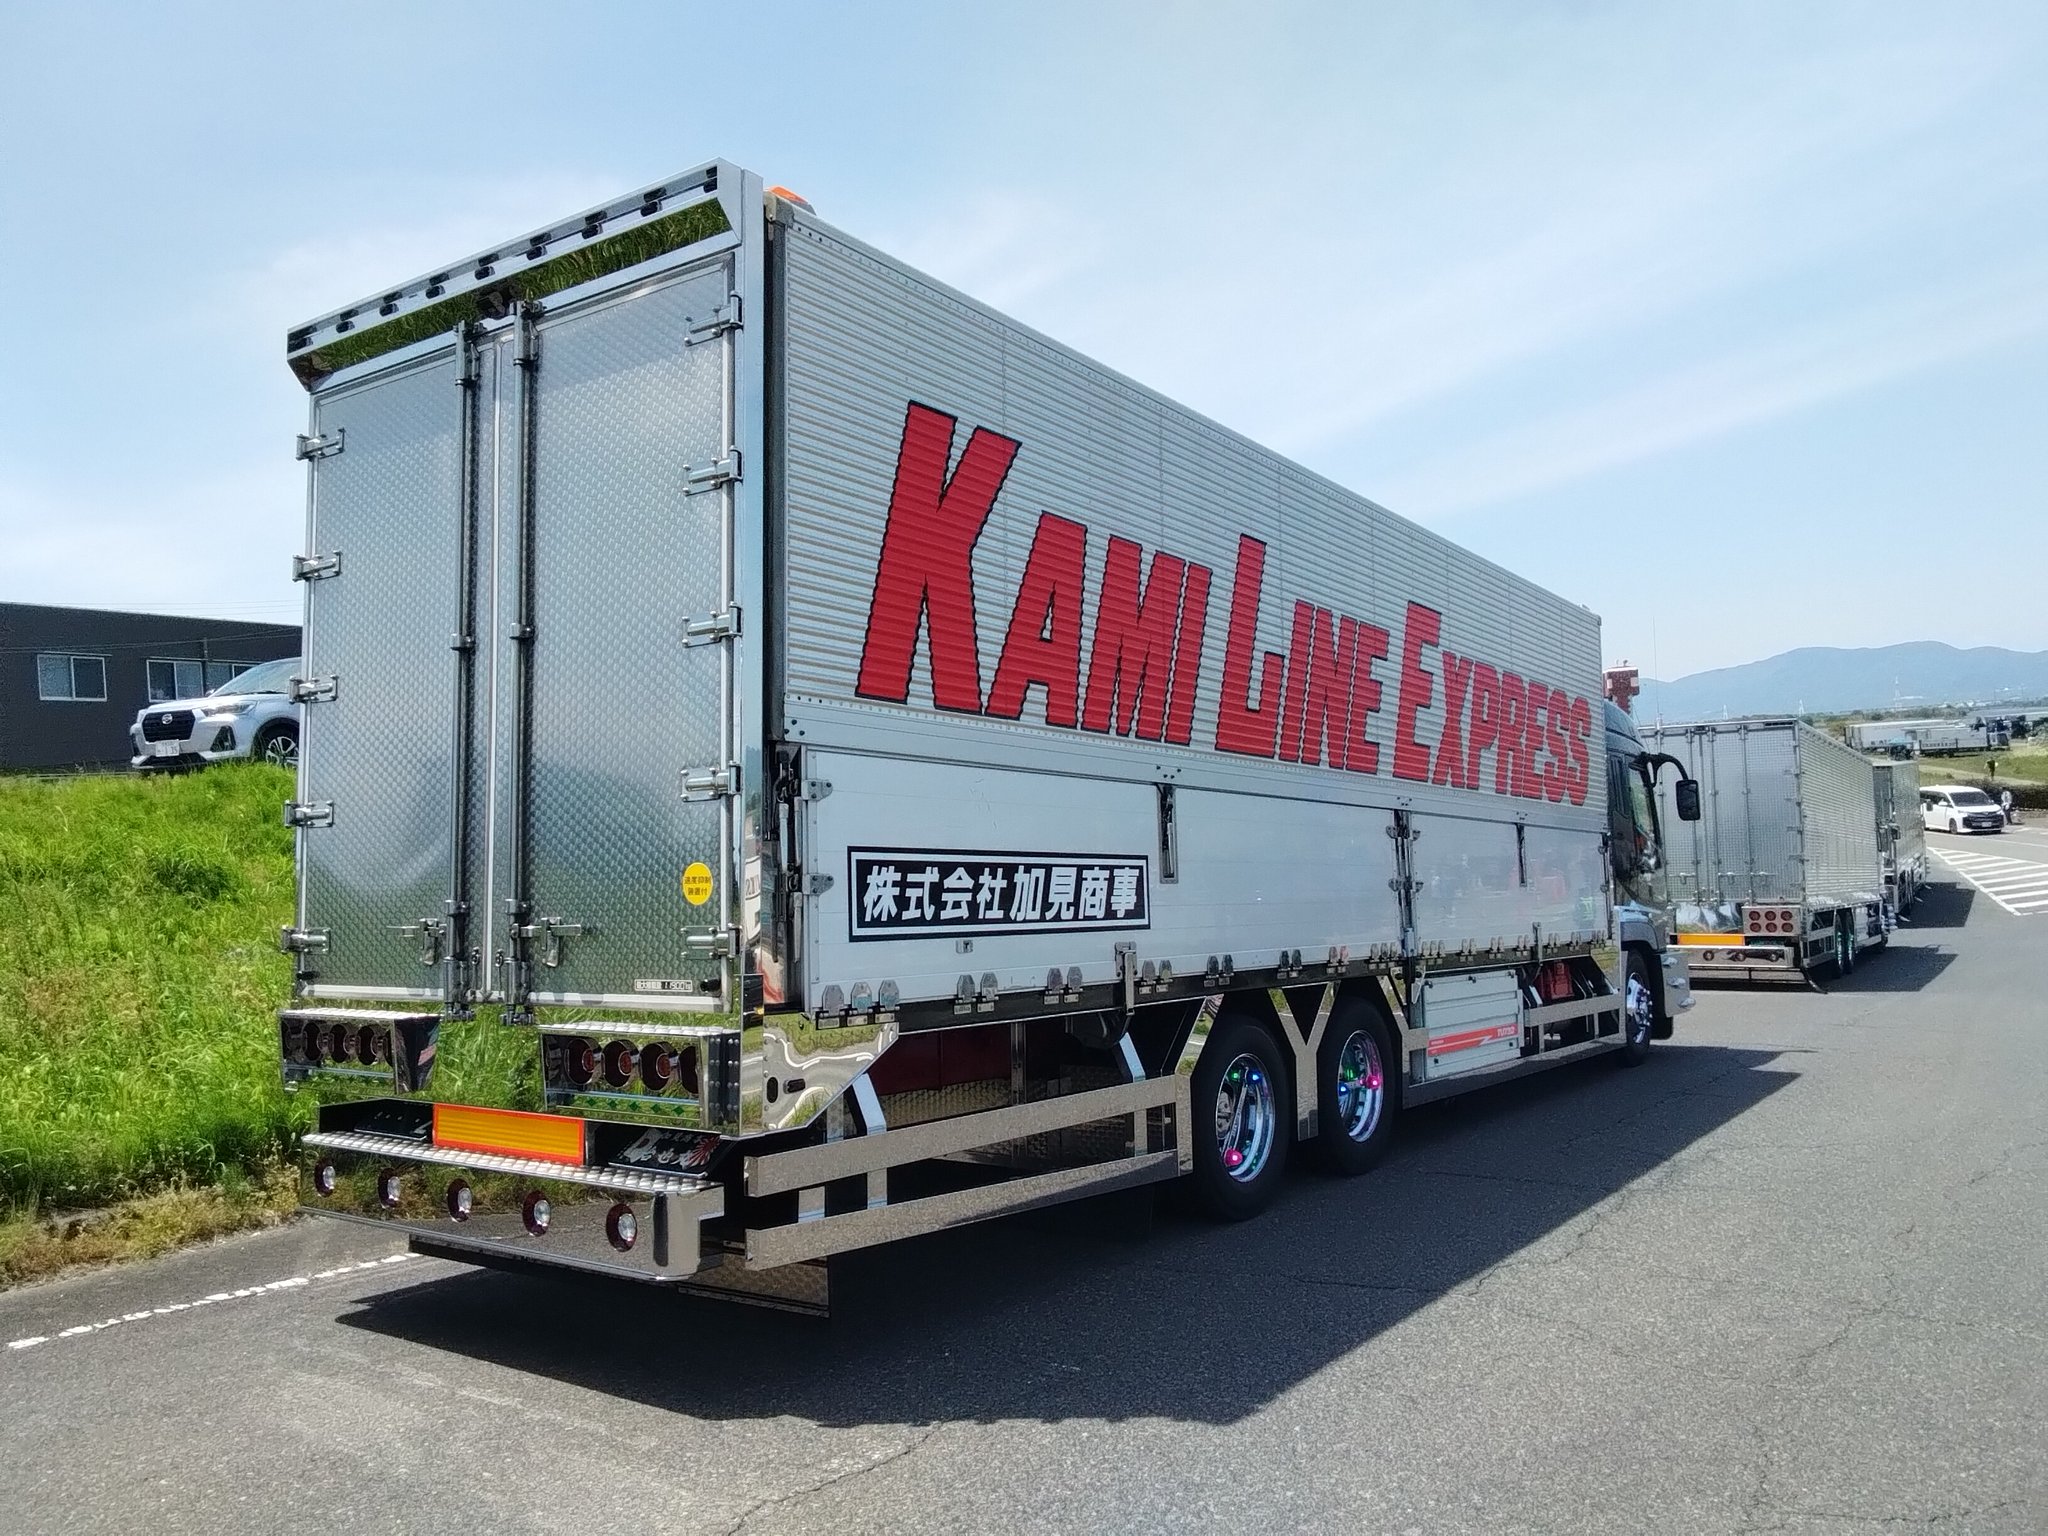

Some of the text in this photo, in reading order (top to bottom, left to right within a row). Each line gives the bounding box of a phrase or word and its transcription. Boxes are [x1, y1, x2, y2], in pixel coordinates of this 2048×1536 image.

[854, 400, 1592, 807] KAMI LINE EXPRESS
